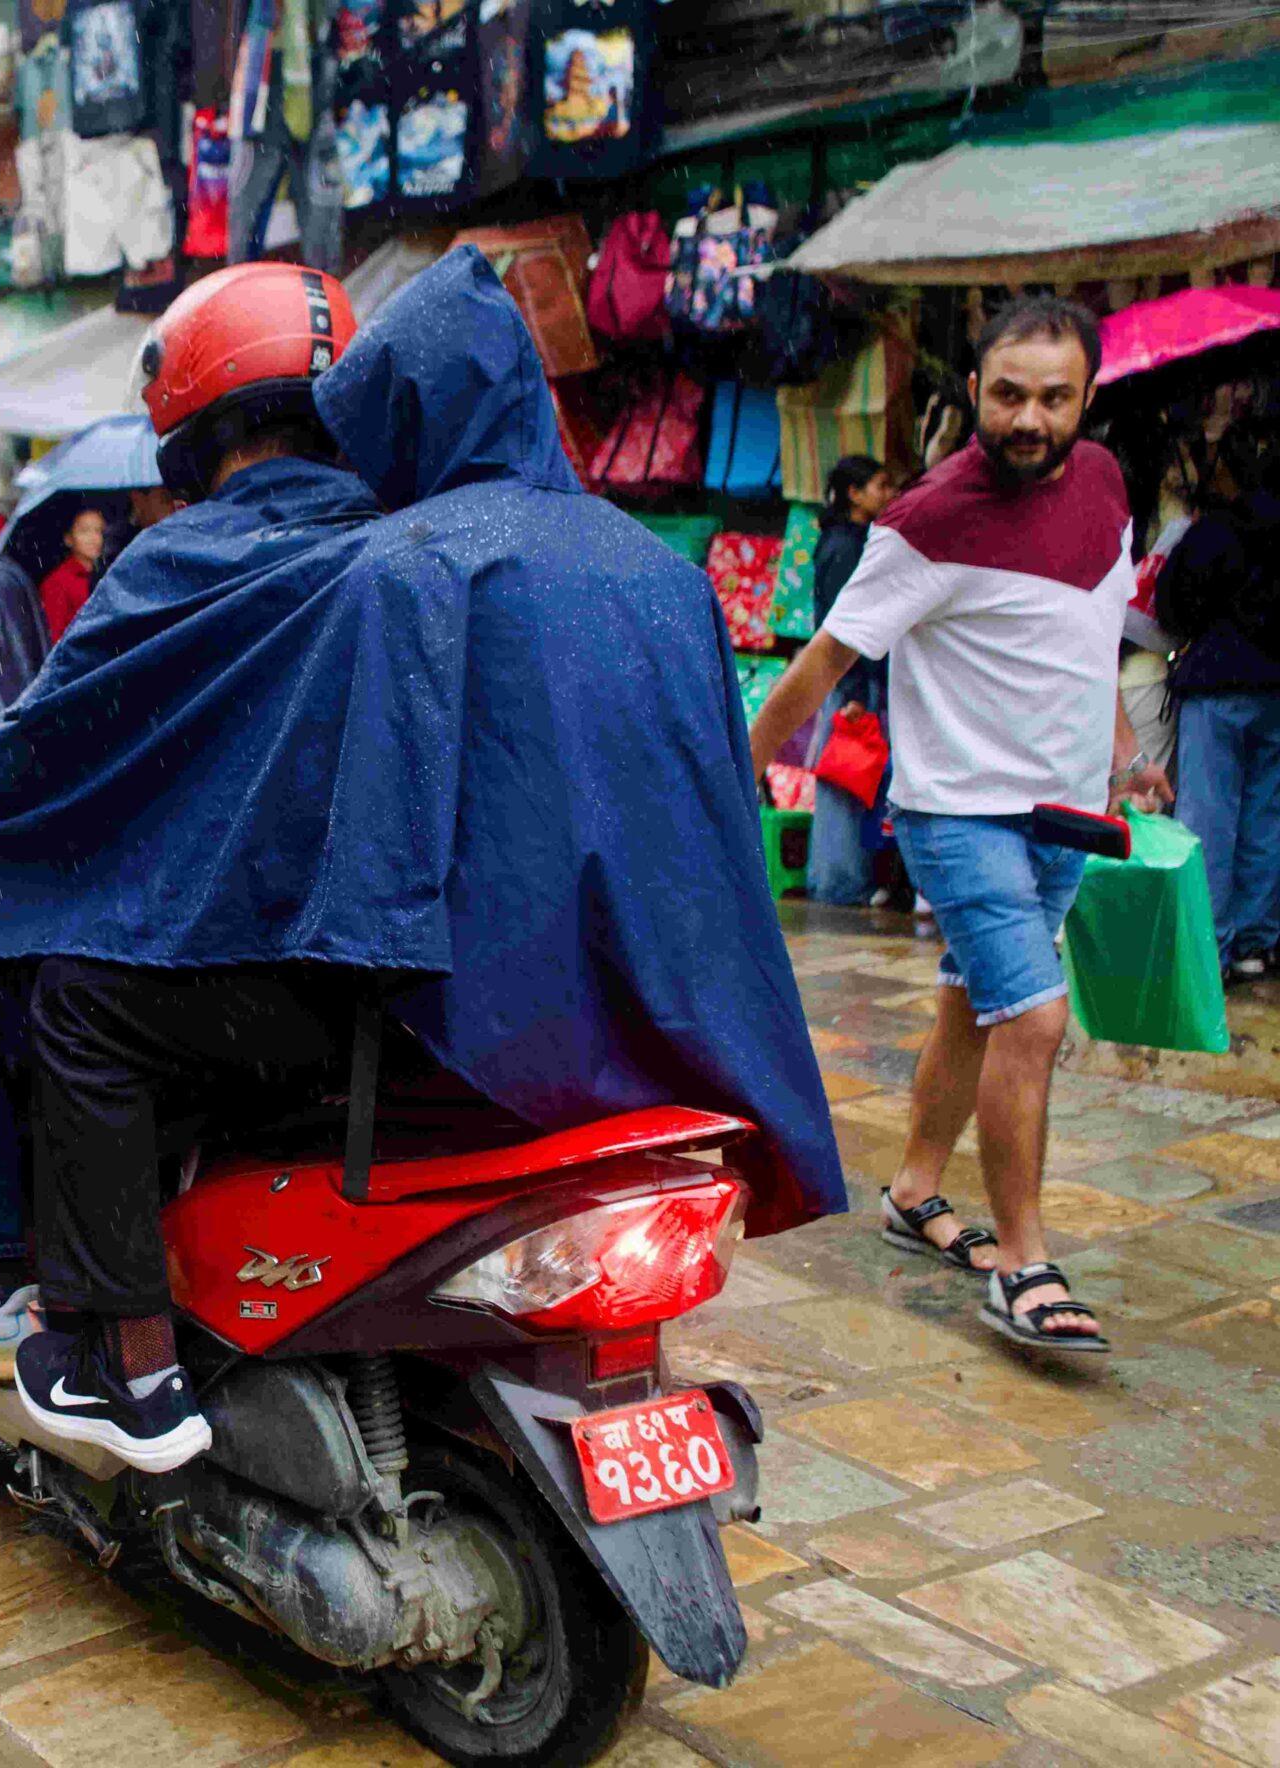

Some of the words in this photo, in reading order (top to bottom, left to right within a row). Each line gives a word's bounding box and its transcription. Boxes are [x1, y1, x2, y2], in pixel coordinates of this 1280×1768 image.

[240, 1302, 276, 1315] HET
[598, 1419, 632, 1449] बा
[597, 1435, 722, 1505] १३६०
